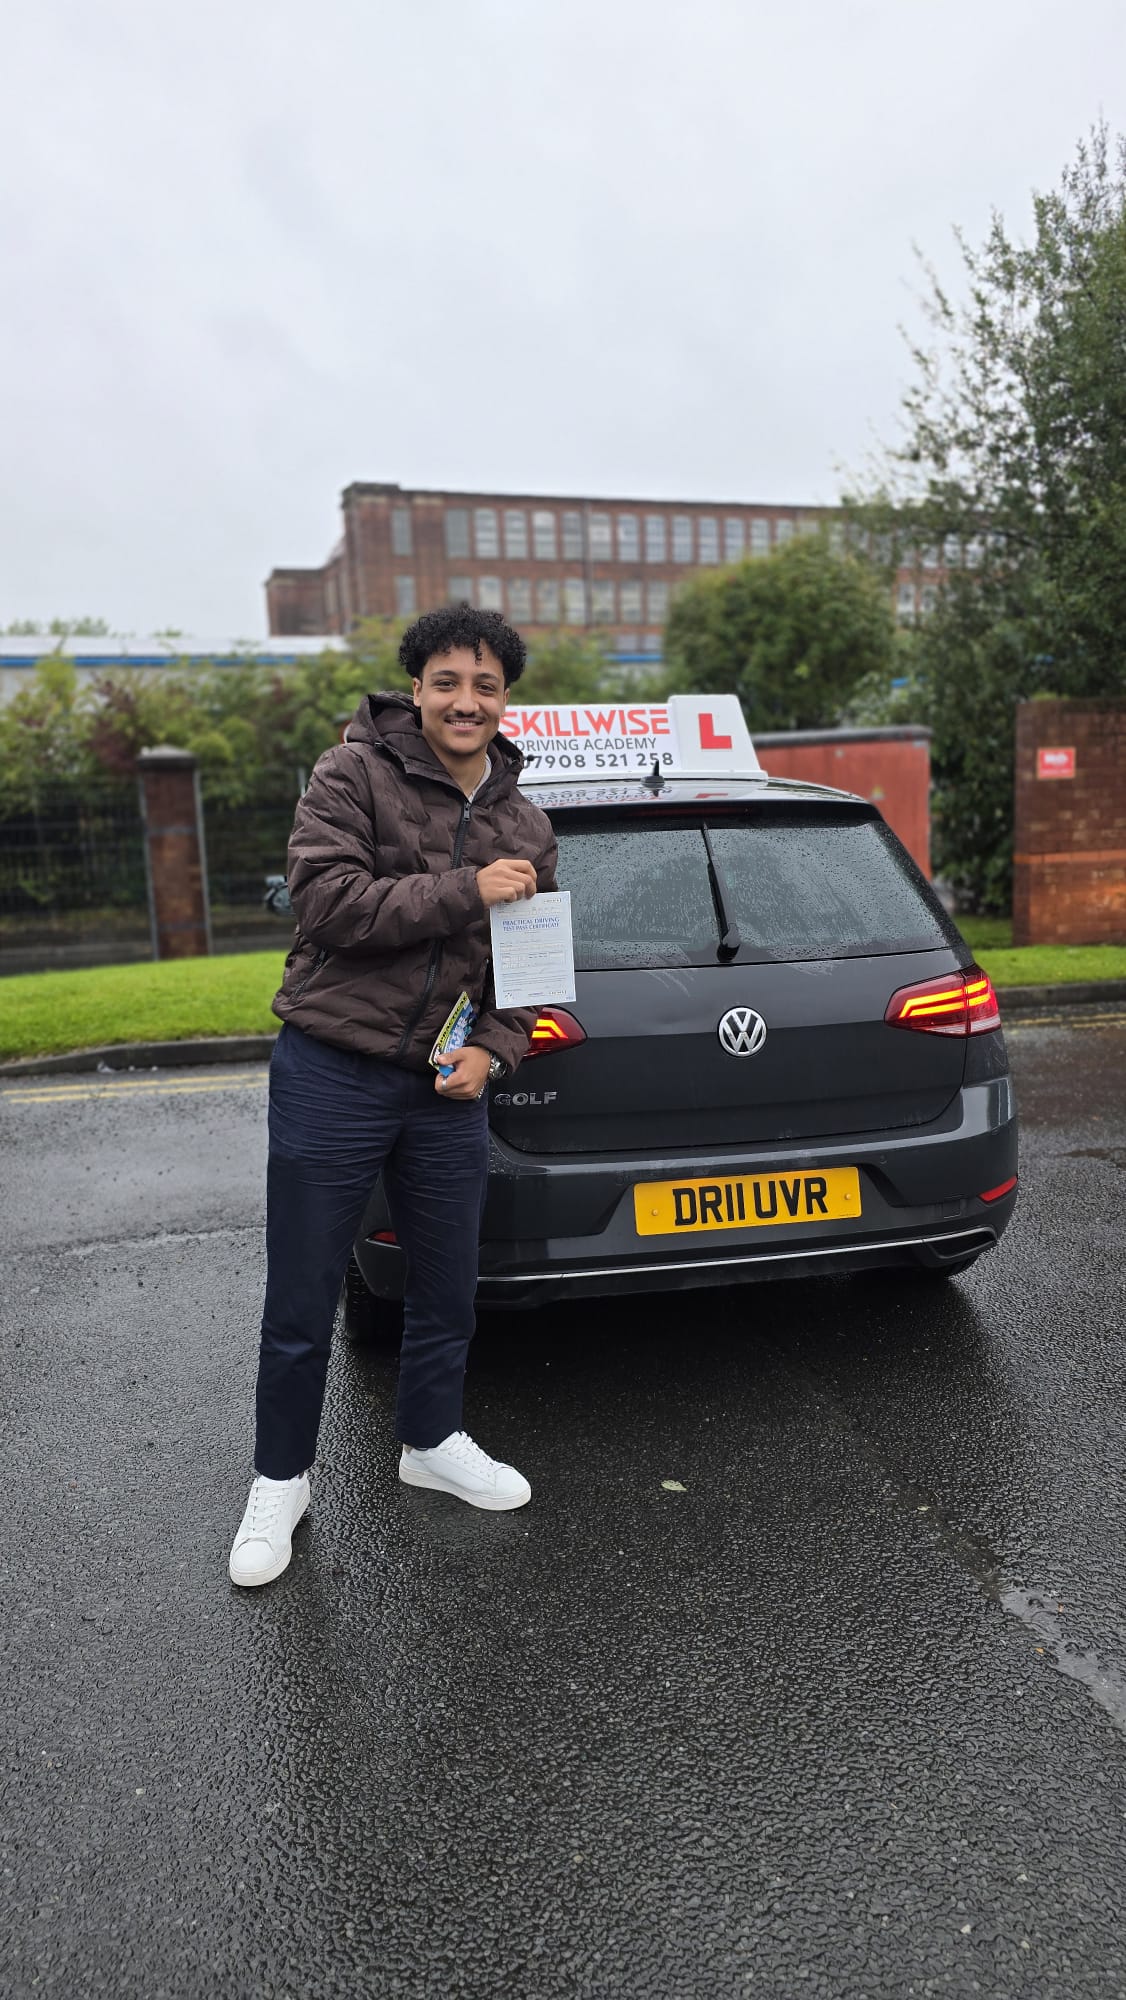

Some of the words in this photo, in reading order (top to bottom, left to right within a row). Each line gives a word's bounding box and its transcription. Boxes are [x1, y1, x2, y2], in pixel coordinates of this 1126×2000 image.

[499, 709, 670, 737] SKILLWISE
[698, 713, 733, 749] L
[515, 739, 579, 751] DRIVING
[584, 737, 657, 750] ACADEMY
[595, 753, 628, 767] 521
[636, 752, 674, 767] 258
[494, 1091, 557, 1106] GOLF
[753, 1176, 828, 1219] UVR
